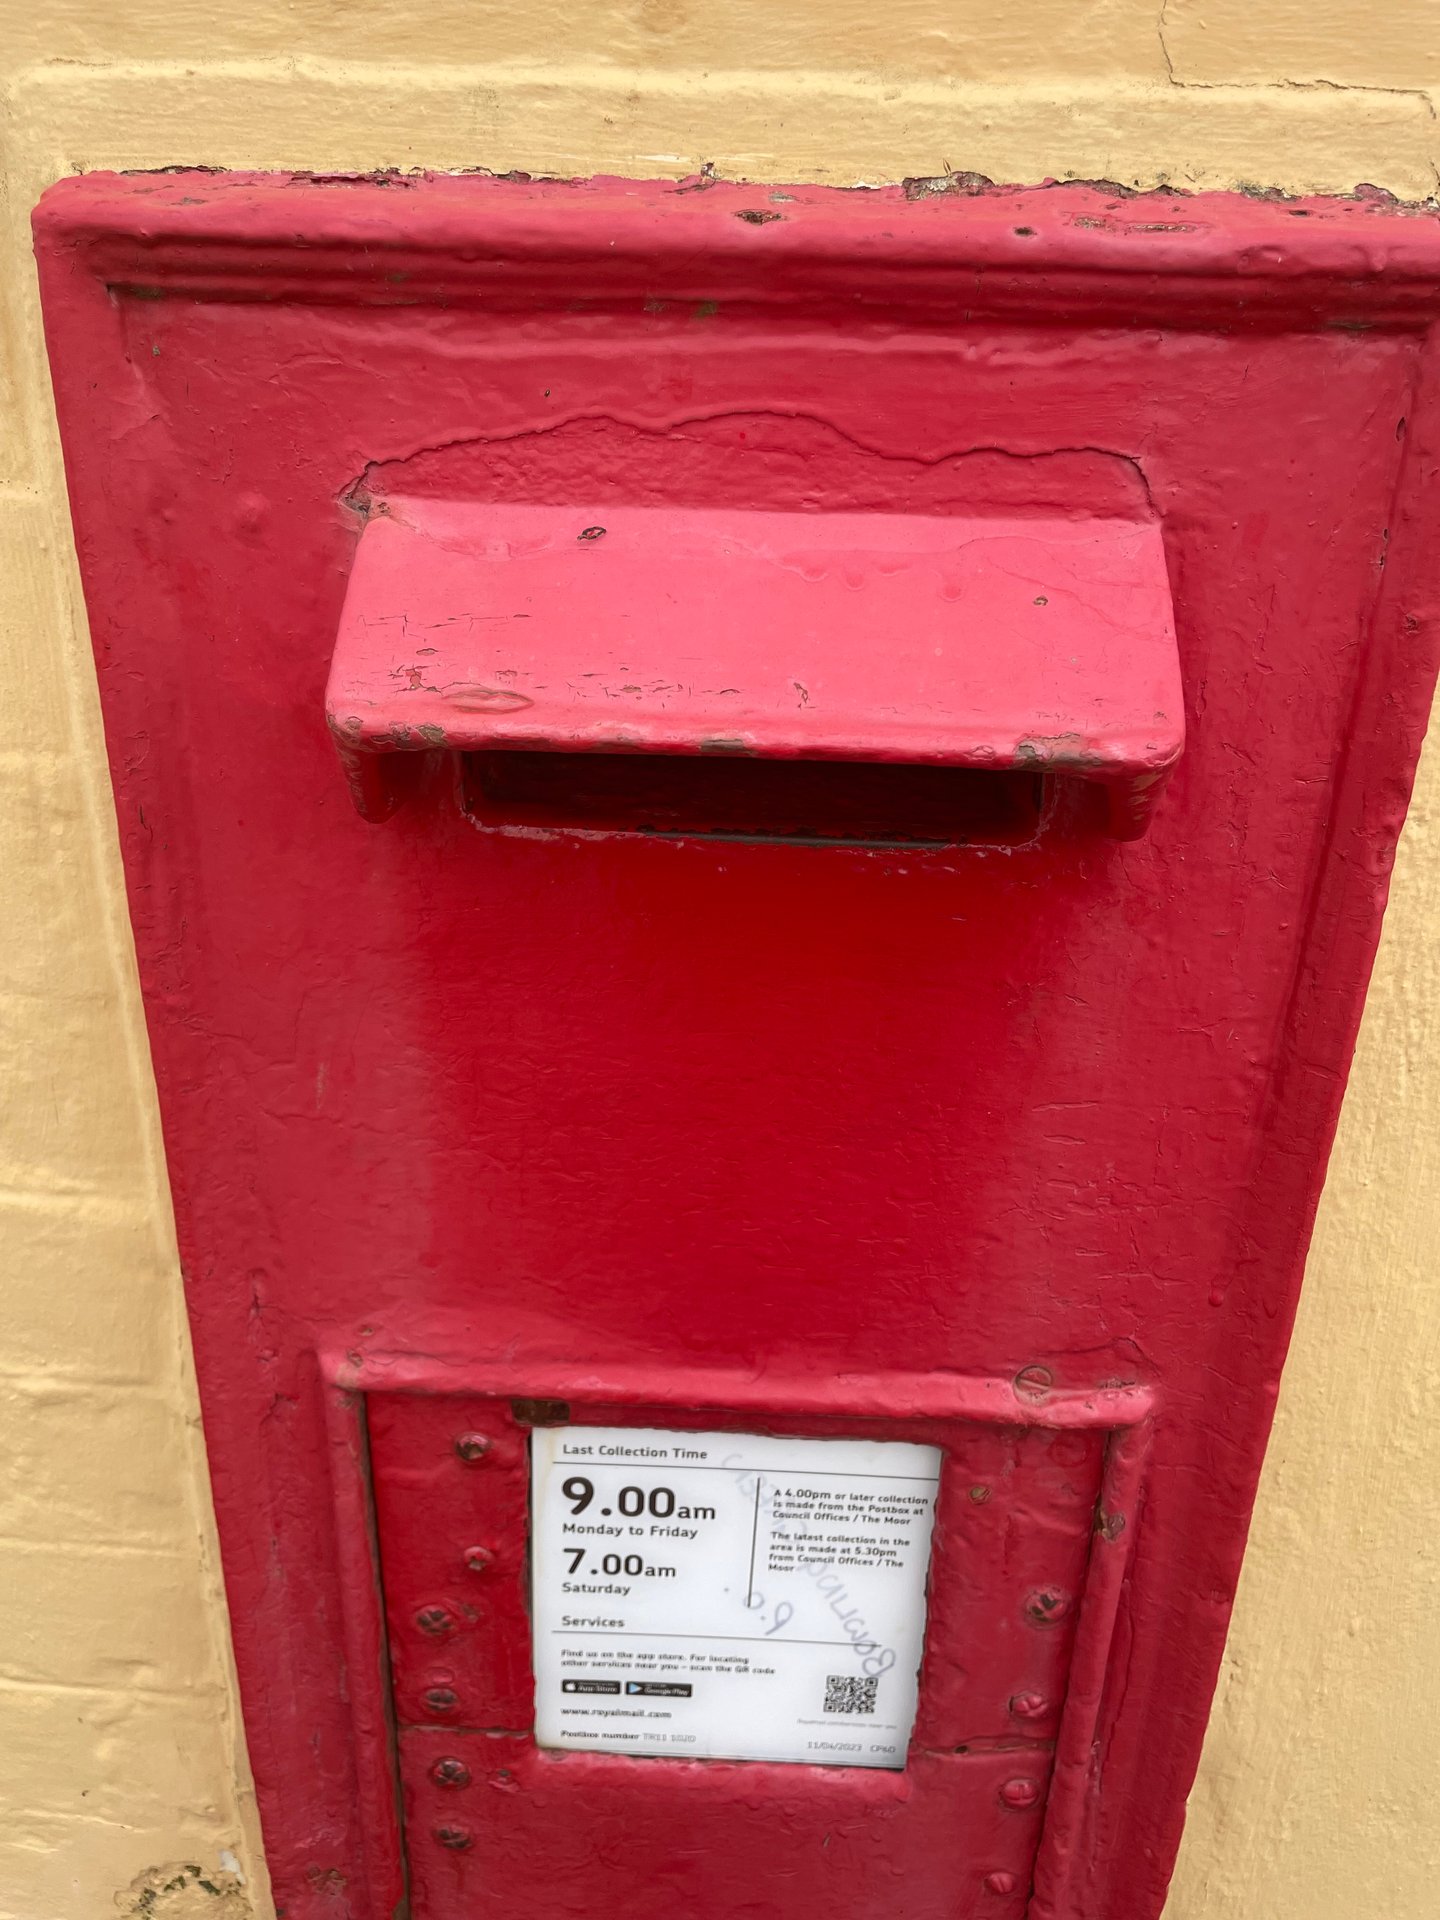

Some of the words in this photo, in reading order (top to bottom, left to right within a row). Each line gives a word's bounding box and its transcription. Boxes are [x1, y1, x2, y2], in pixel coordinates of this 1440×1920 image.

[563, 1444, 593, 1455] Last
[598, 1445, 668, 1458] Collection
[672, 1448, 708, 1459] Time
[562, 1476, 716, 1520] 9.00am
[774, 1489, 781, 1497] A
[785, 1489, 831, 1500] 4.00pm
[850, 1493, 875, 1502] later
[878, 1494, 928, 1504] collection
[773, 1500, 782, 1508] is
[786, 1501, 815, 1509] made
[818, 1502, 844, 1511] from
[847, 1504, 864, 1512] the
[868, 1505, 909, 1515] Postbox
[912, 1508, 924, 1516] at
[772, 1511, 810, 1520] Council
[814, 1512, 850, 1522] Offices
[853, 1514, 858, 1523] /
[861, 1515, 880, 1524] The
[884, 1516, 911, 1525] Moor
[562, 1523, 623, 1537] Monday
[629, 1525, 644, 1536] to
[650, 1526, 698, 1540] Friday
[770, 1532, 790, 1540] The
[794, 1532, 823, 1542] latest
[826, 1534, 876, 1544] collection
[879, 1537, 889, 1545] in
[892, 1538, 910, 1546] the
[769, 1544, 792, 1552] area
[795, 1544, 804, 1552] is
[808, 1545, 837, 1553] made
[840, 1547, 850, 1555] at
[855, 1547, 897, 1557] 5.30pm
[563, 1548, 676, 1577] 7.00am
[768, 1563, 794, 1572] Moor
[769, 1553, 794, 1562] from
[797, 1554, 835, 1564] Council
[838, 1556, 874, 1566] Offices
[876, 1558, 882, 1567] /
[884, 1559, 904, 1568] The
[562, 1582, 631, 1596] Saturday
[561, 1615, 625, 1628] Services
[561, 1649, 583, 1658] Find
[586, 1650, 598, 1658] us
[617, 1651, 633, 1659] the
[637, 1652, 654, 1661] app
[690, 1653, 706, 1662] For
[709, 1655, 749, 1664] locating
[561, 1659, 588, 1668] other
[591, 1660, 632, 1669] services
[635, 1662, 657, 1670] near
[660, 1662, 679, 1672] you
[690, 1664, 713, 1672] scan
[715, 1664, 732, 1673] the
[735, 1666, 750, 1674] QR
[752, 1666, 775, 1675] code
[561, 1708, 672, 1719] www.royalmail.com
[561, 1730, 599, 1739] Postbox
[601, 1732, 640, 1740] number
